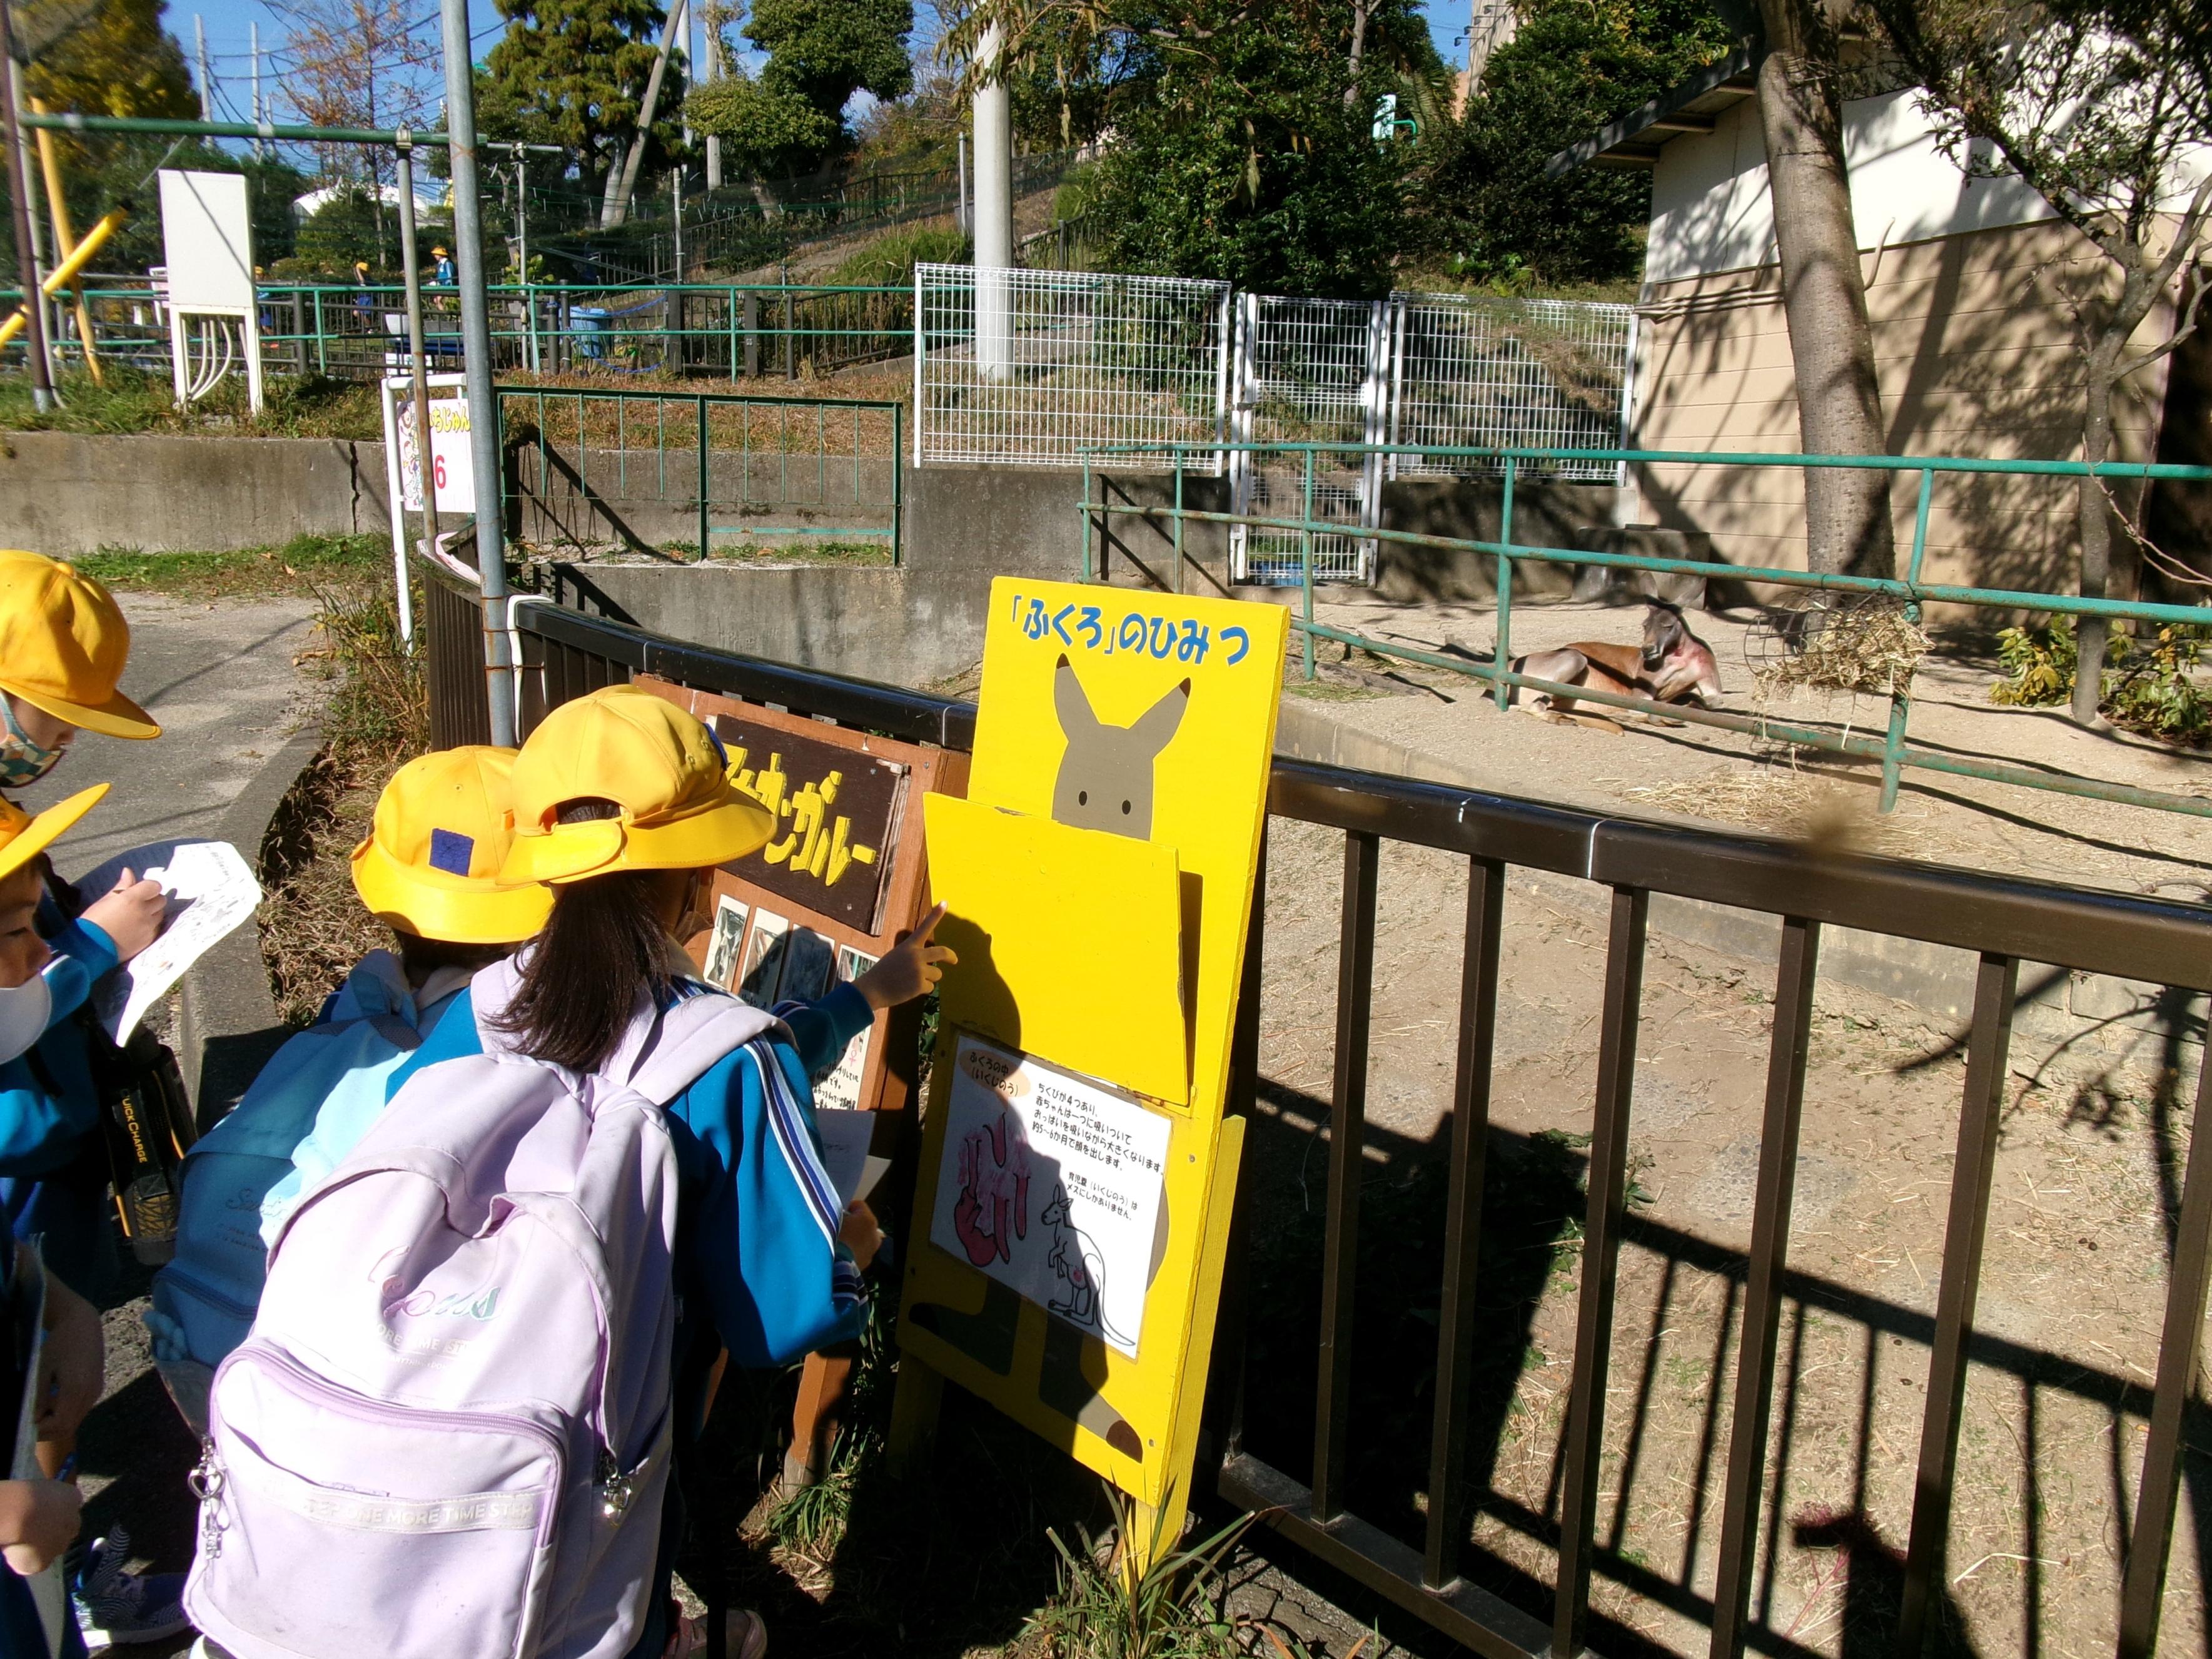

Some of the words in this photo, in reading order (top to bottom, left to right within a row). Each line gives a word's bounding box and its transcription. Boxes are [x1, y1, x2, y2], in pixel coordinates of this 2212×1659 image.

[435, 455, 446, 489] 6
[1011, 594, 1250, 667] 「ふくろ」のひみつ
[969, 1052, 1009, 1076] ふくろの中
[128, 1122, 148, 1163] CHARGE
[386, 1507, 440, 1526] MORE
[442, 1503, 486, 1523] TIME
